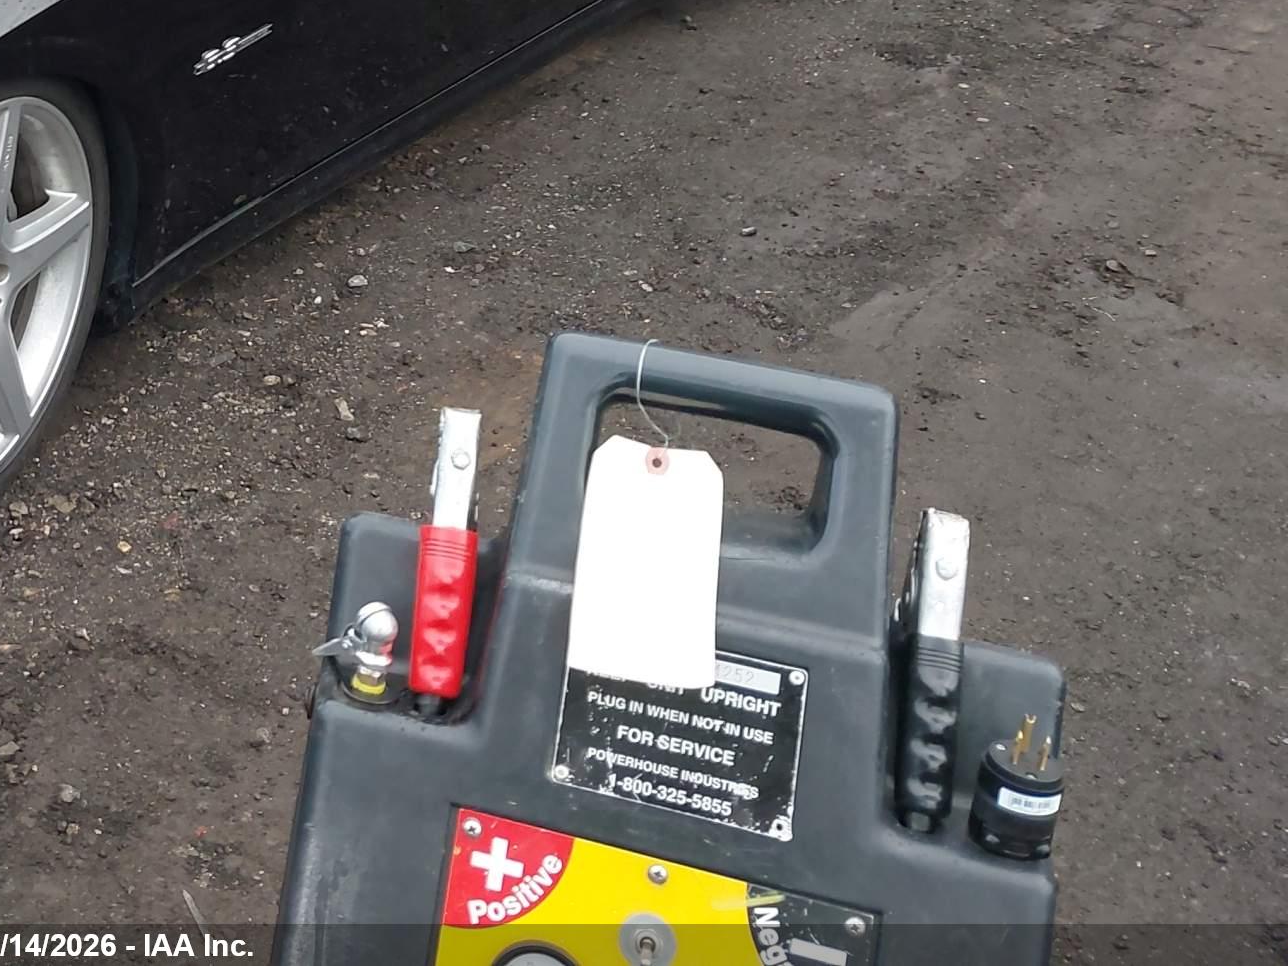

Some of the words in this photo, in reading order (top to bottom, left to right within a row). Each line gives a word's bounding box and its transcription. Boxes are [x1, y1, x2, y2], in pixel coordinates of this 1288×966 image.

[587, 690, 627, 711] PLUG
[629, 701, 645, 714] IN
[647, 704, 689, 726] WHEN
[692, 714, 723, 733] NOT
[726, 722, 741, 736] IN
[744, 726, 774, 745] USE
[701, 687, 781, 717] UPRIGHT
[617, 724, 655, 746] FOR
[657, 733, 736, 767] SERVICE
[587, 747, 679, 778] POWERHOUSE
[681, 770, 760, 800] INDUSTRIES
[608, 773, 732, 817] 1-800-325-5855
[467, 854, 563, 925] Positive
